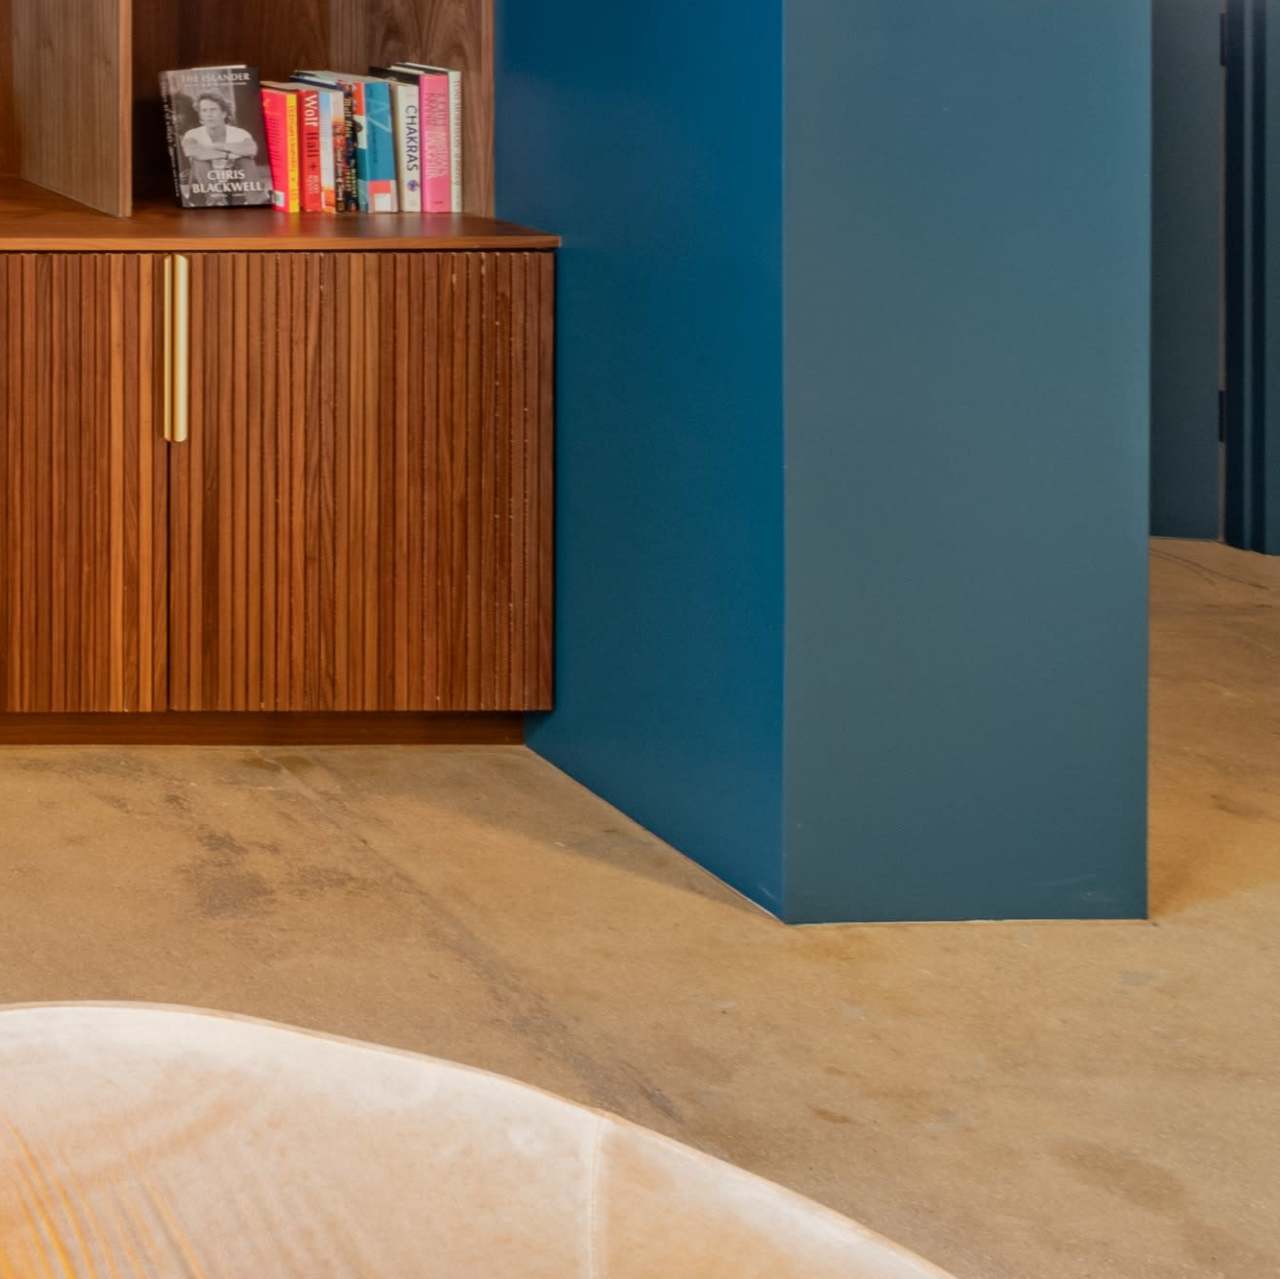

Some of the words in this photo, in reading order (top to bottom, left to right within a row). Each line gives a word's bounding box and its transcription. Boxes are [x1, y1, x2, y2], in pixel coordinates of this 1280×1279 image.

[200, 72, 251, 82] ISLANDER
[305, 94, 318, 127] Wolf
[306, 132, 318, 158] Hall
[405, 104, 418, 172] CHAKRAS
[207, 169, 246, 181] CHRIS
[191, 180, 264, 194] BLACKWELL
